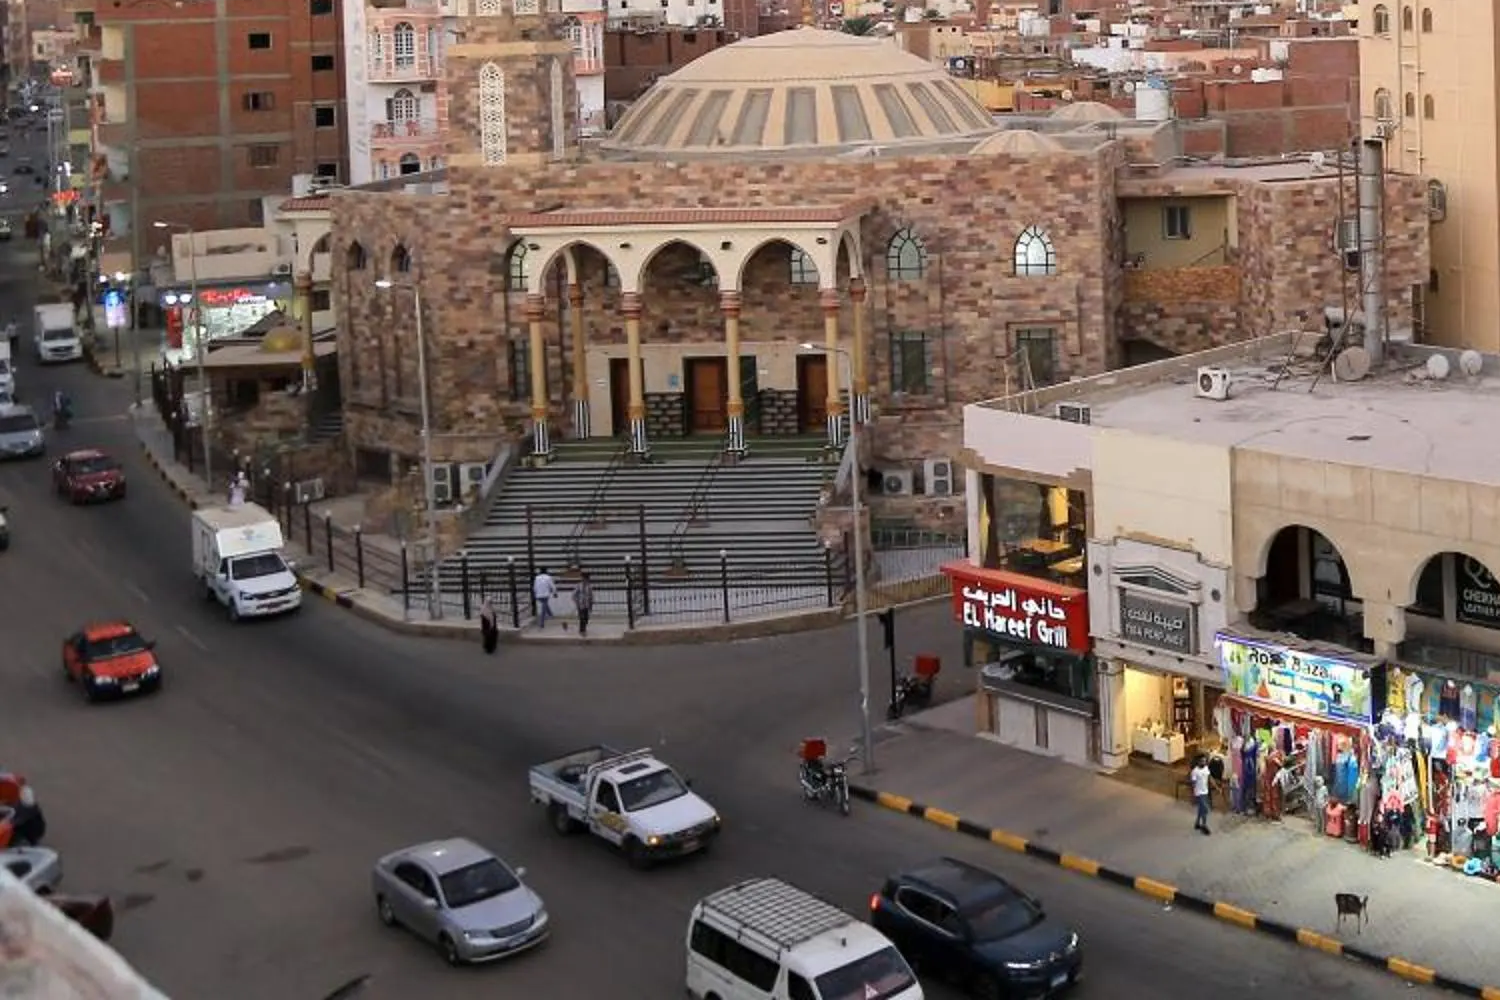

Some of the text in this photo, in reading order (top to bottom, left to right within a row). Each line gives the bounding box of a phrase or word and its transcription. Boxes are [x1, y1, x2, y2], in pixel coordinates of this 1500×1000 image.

[963, 601, 1068, 649] EL Hareef Grill
